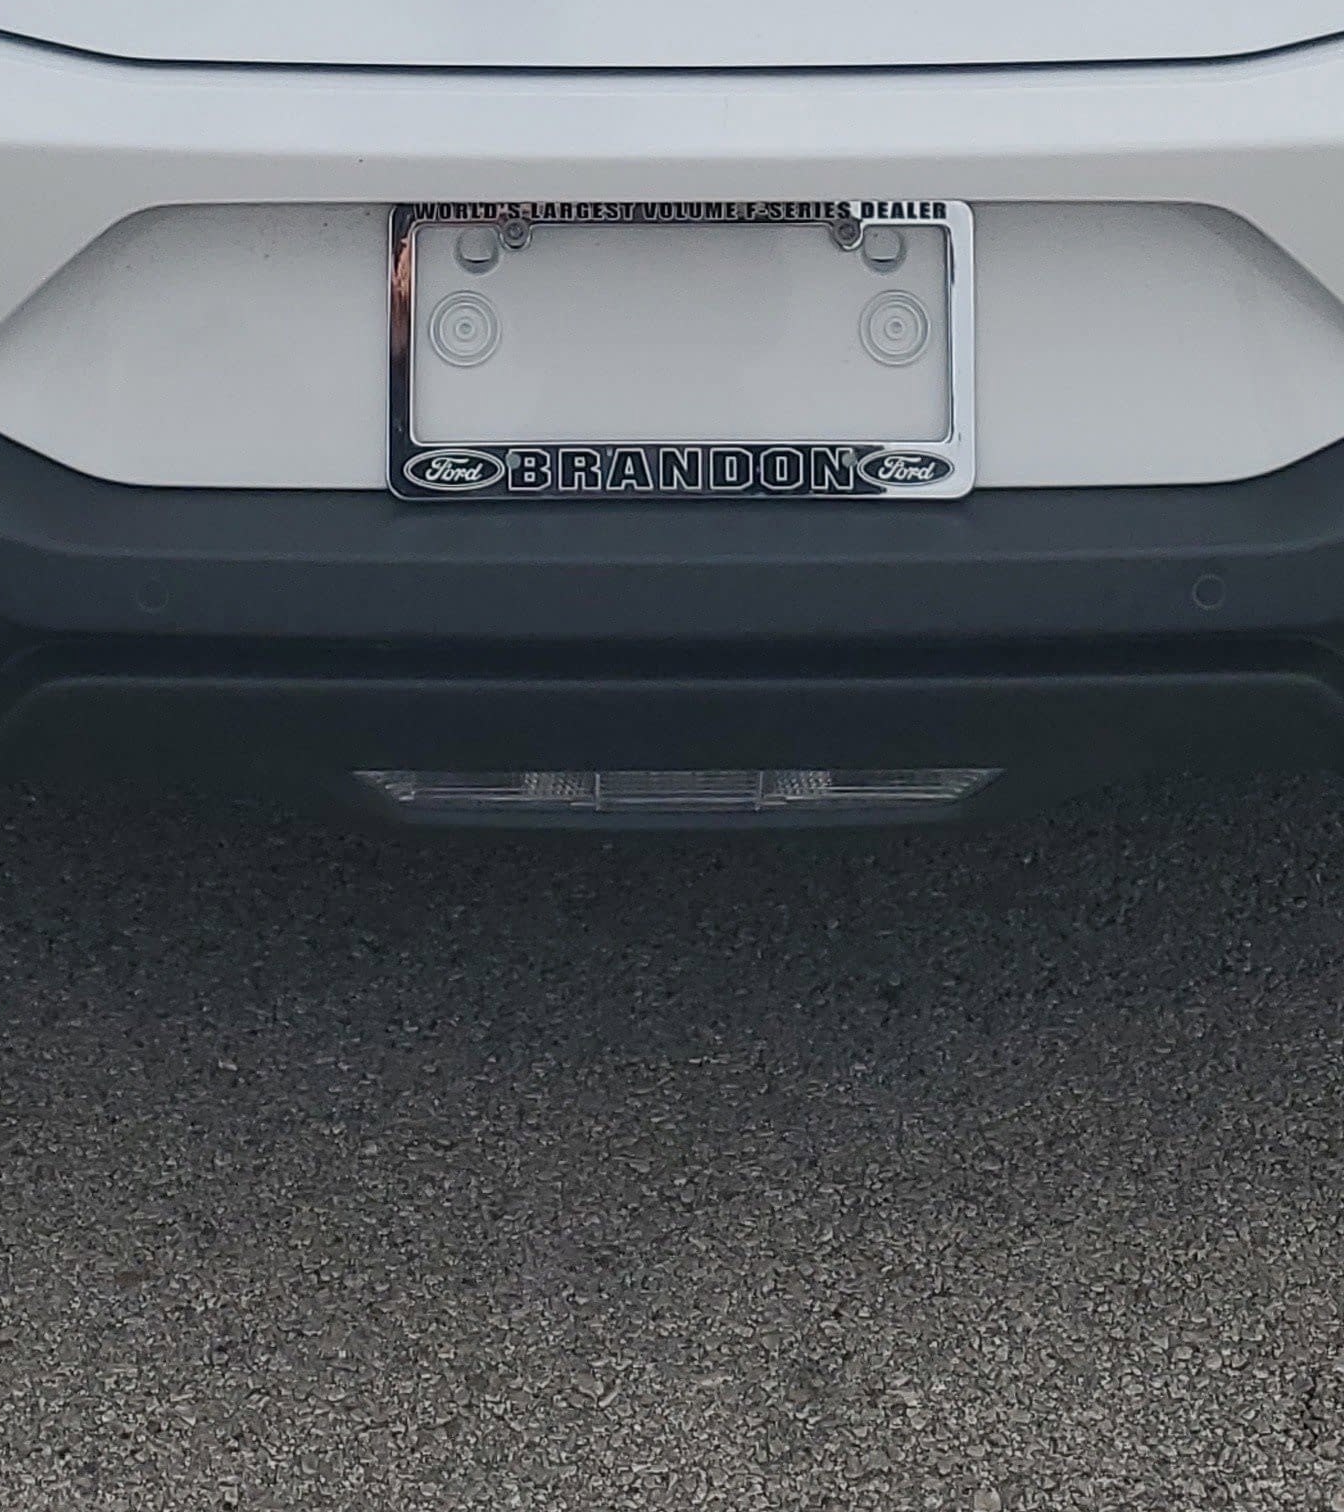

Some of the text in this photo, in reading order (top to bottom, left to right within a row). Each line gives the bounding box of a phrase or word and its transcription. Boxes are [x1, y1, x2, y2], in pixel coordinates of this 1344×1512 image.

[415, 202, 947, 220] WORLD'S LARGEST VOLUME F-SERIES DEALER
[424, 448, 937, 491] Ford BRANDON Ford
